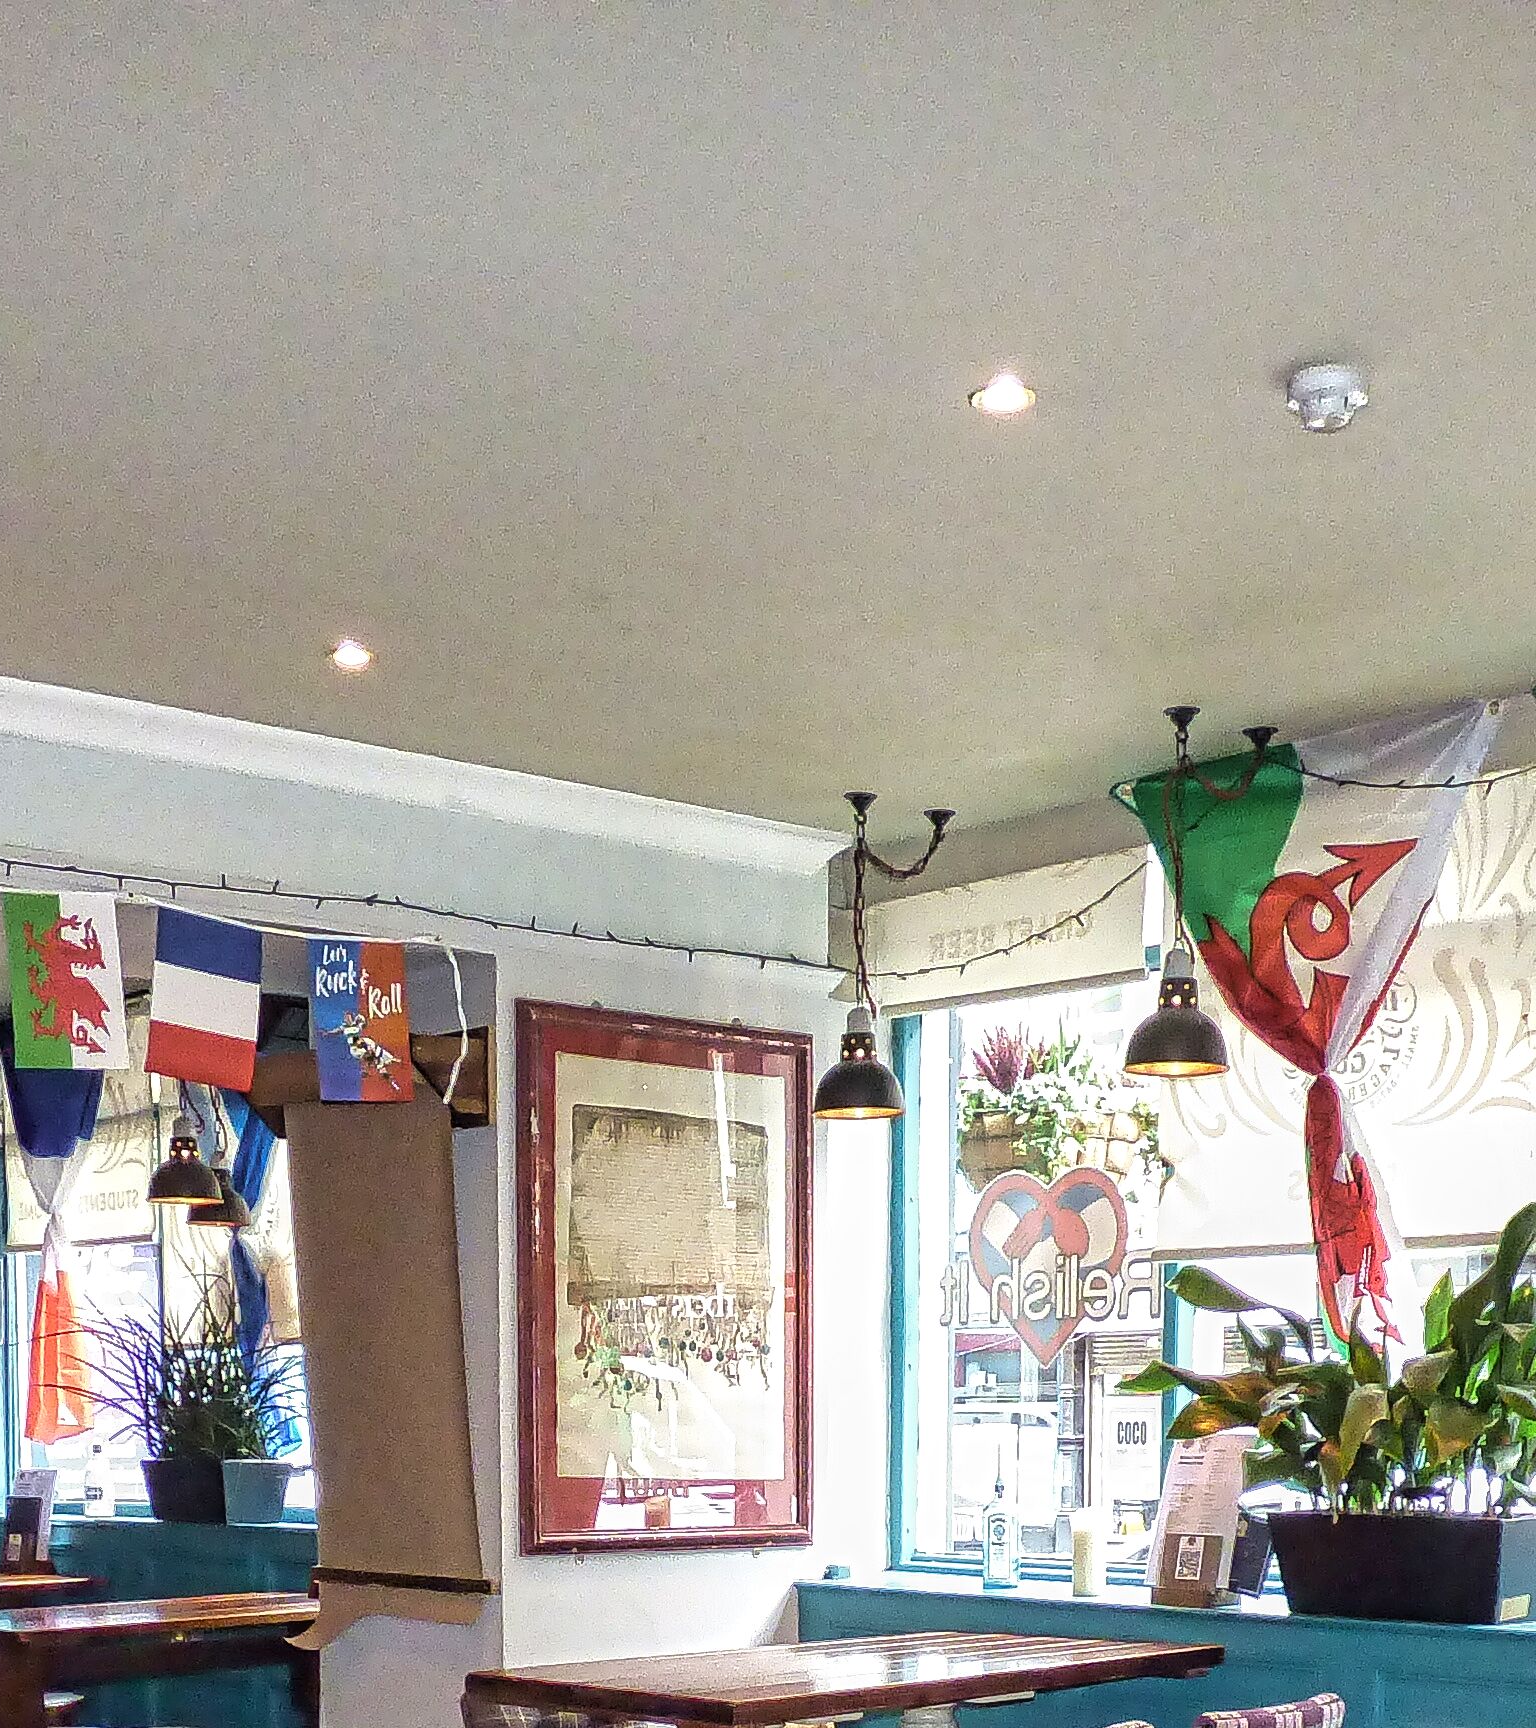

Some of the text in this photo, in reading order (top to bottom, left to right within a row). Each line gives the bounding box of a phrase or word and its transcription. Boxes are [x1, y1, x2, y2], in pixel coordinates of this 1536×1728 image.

[315, 960, 358, 998] Ruck
[368, 983, 403, 1019] Roll
[1117, 1421, 1147, 1446] COCO
